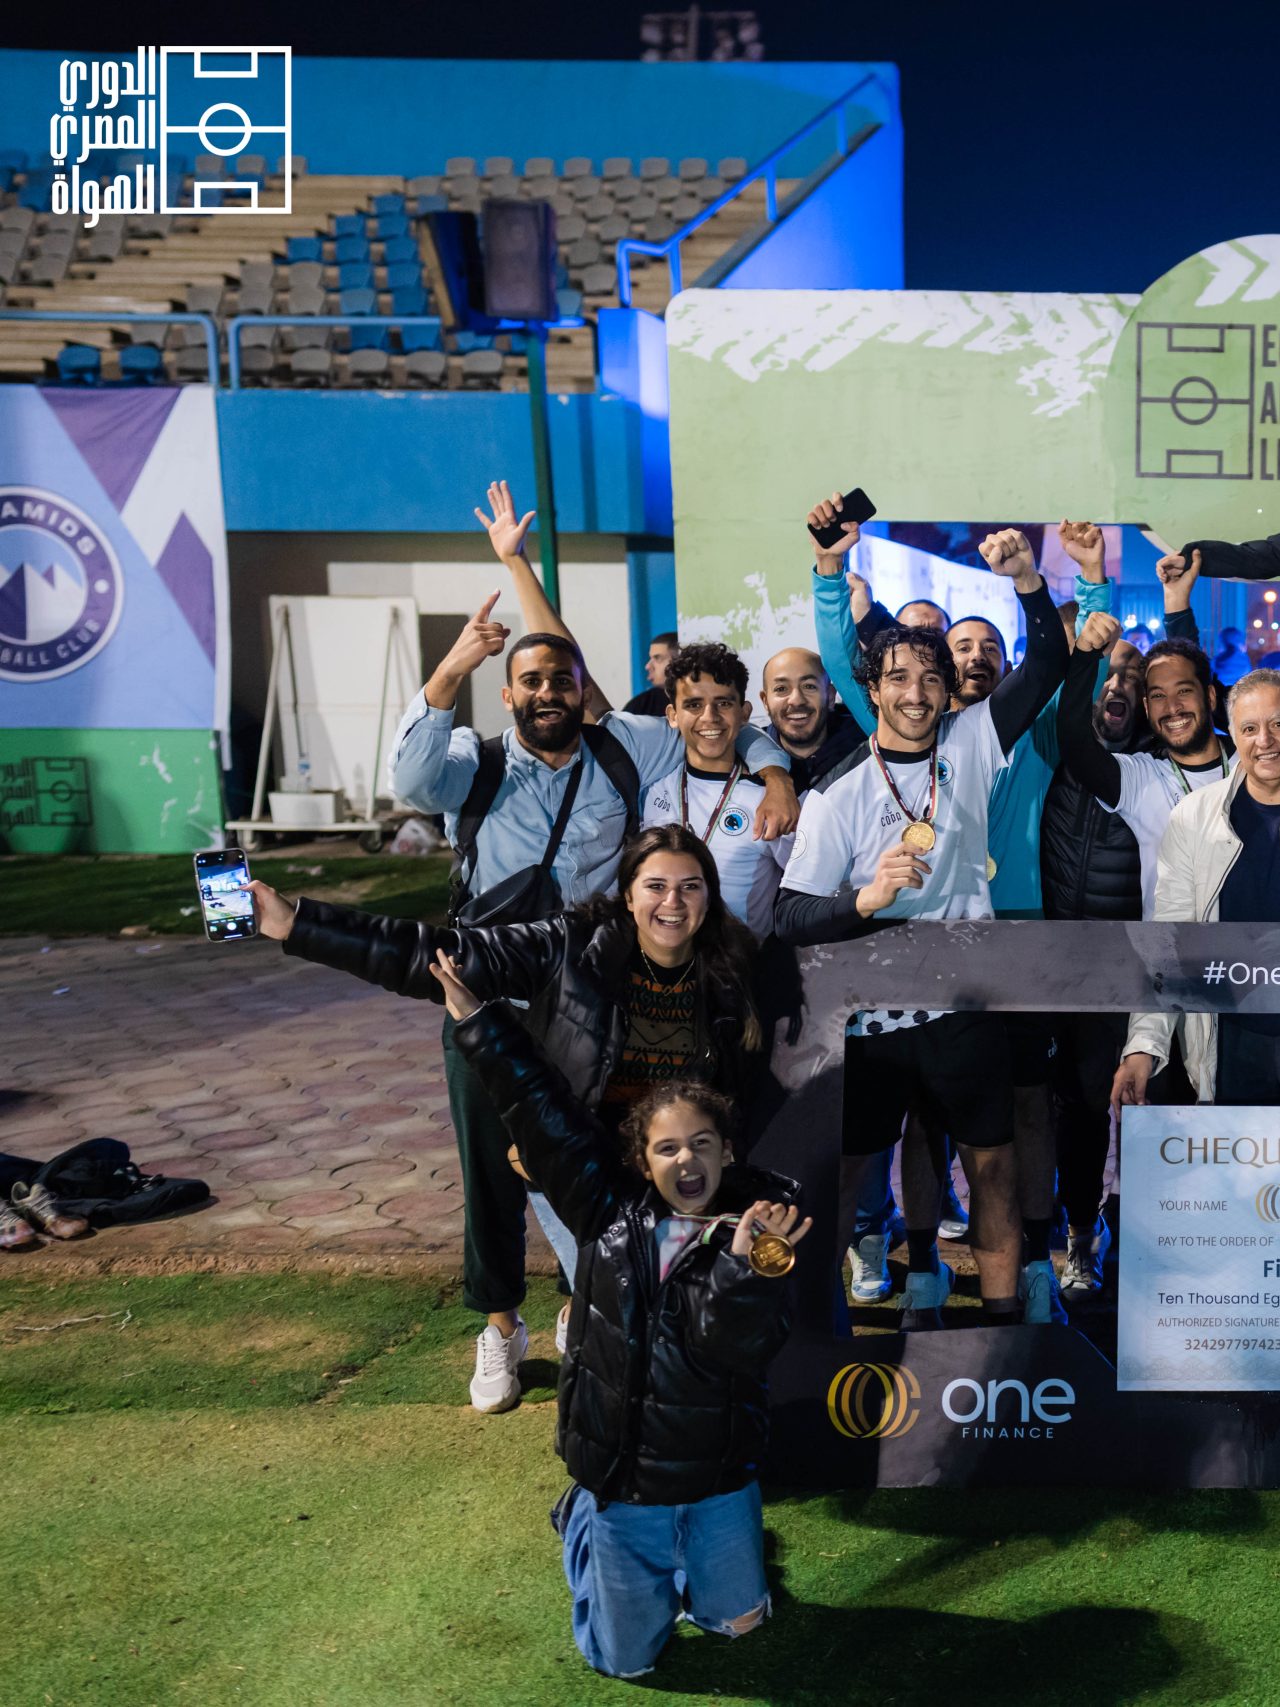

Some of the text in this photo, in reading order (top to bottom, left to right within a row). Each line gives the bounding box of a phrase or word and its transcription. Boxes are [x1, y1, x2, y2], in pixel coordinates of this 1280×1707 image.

[56, 618, 101, 660] CLUB
[1159, 1200, 1228, 1212] YOUR NAME
[1158, 1236, 1274, 1247] PAY TO THE ORDER OF
[1157, 1292, 1184, 1305] Ten
[1188, 1292, 1260, 1305] Thousand
[1157, 1317, 1280, 1328] AUTHORIZED SIGNATURE
[941, 1377, 1076, 1424] one
[962, 1427, 1055, 1439] FINANCE
